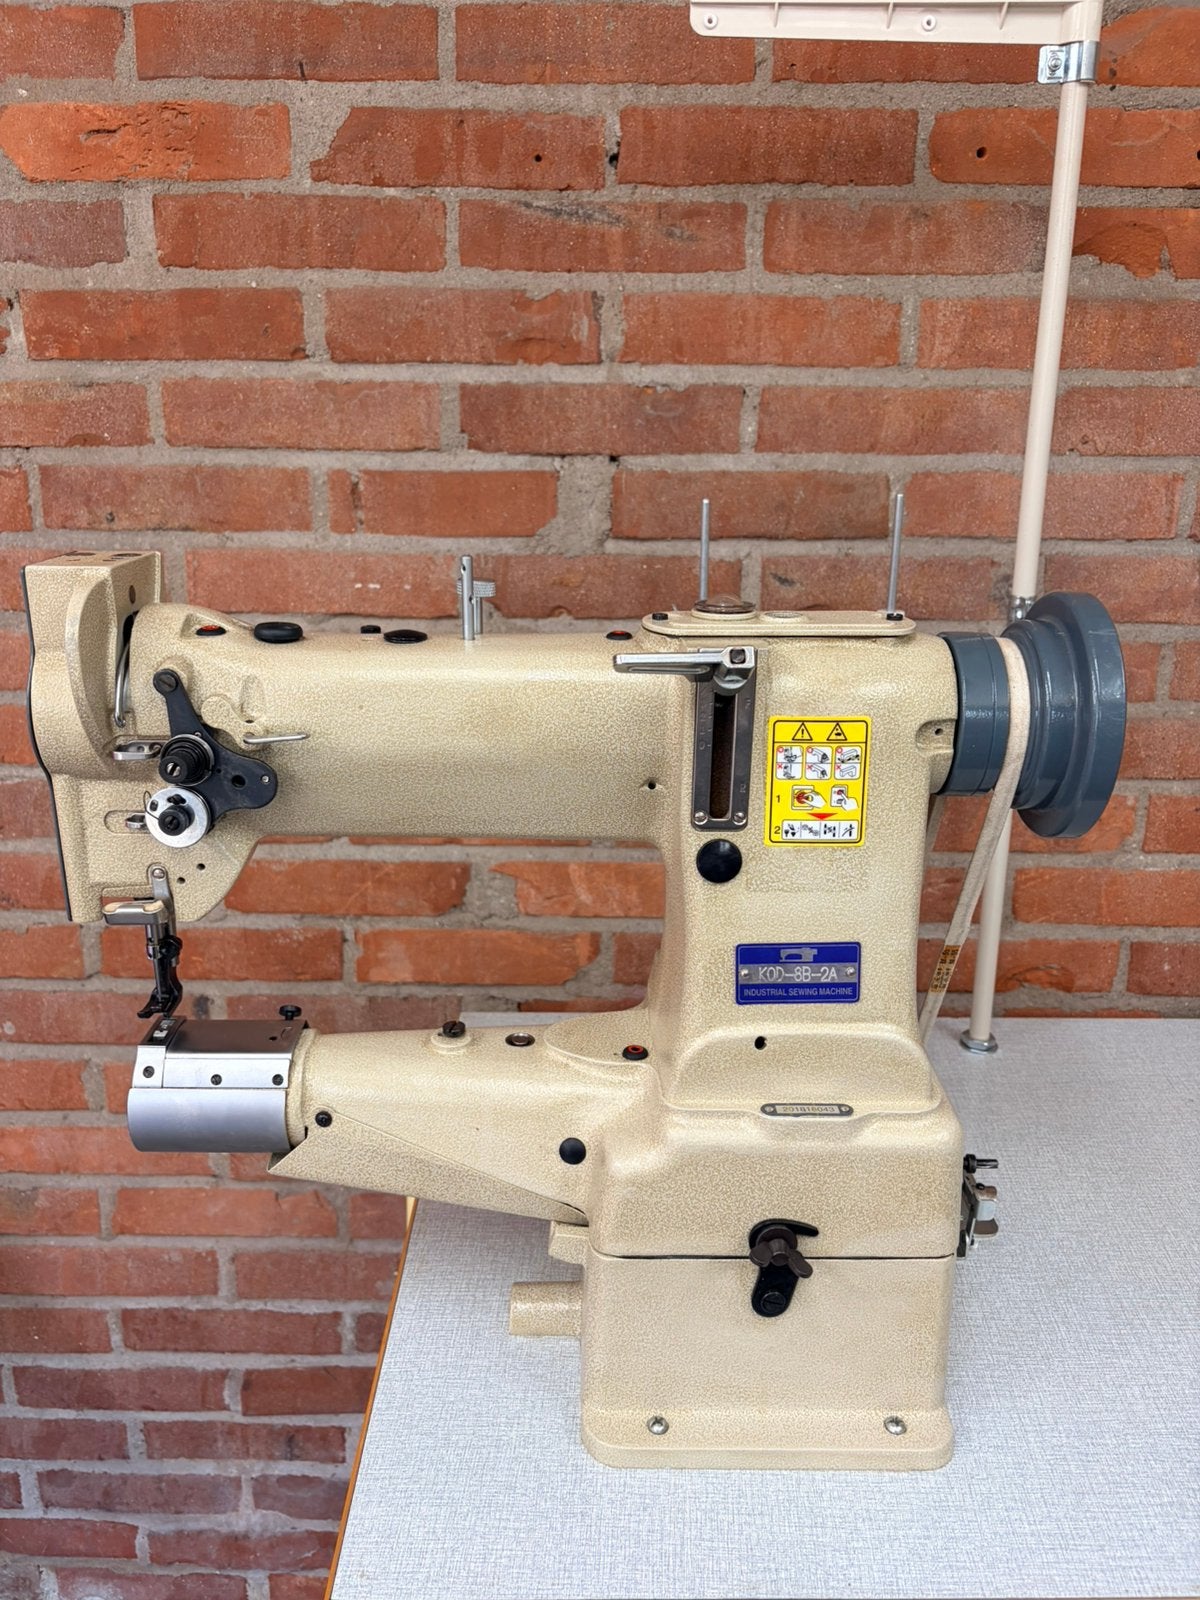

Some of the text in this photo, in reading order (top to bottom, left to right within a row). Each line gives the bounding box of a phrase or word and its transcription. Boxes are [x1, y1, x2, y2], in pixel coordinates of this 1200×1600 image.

[774, 826, 781, 835] 2
[743, 986, 853, 997] INDUSTRIAL SEWING MACHINE
